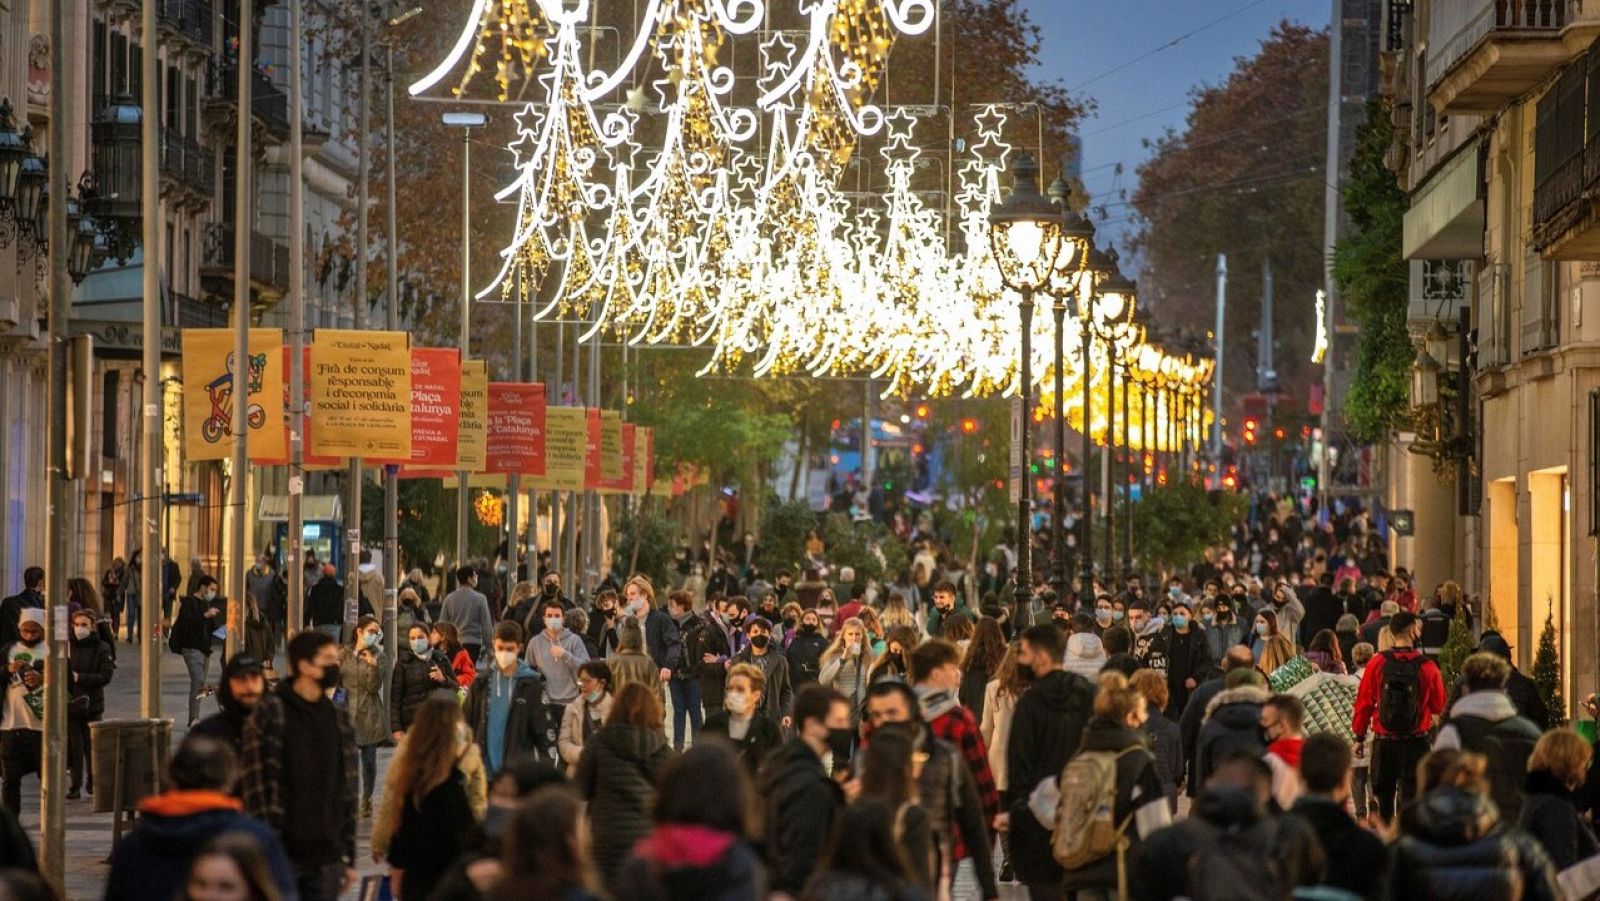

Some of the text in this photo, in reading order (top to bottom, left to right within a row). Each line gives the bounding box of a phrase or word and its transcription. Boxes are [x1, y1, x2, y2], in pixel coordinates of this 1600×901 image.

[343, 364, 358, 374] de
[361, 366, 406, 377] consum
[326, 388, 330, 397] i
[411, 391, 442, 404] Plaça
[317, 401, 405, 413] social i solidària
[411, 404, 452, 416] talunya
[504, 416, 532, 427] Plaça
[493, 425, 540, 436] Catalunya
